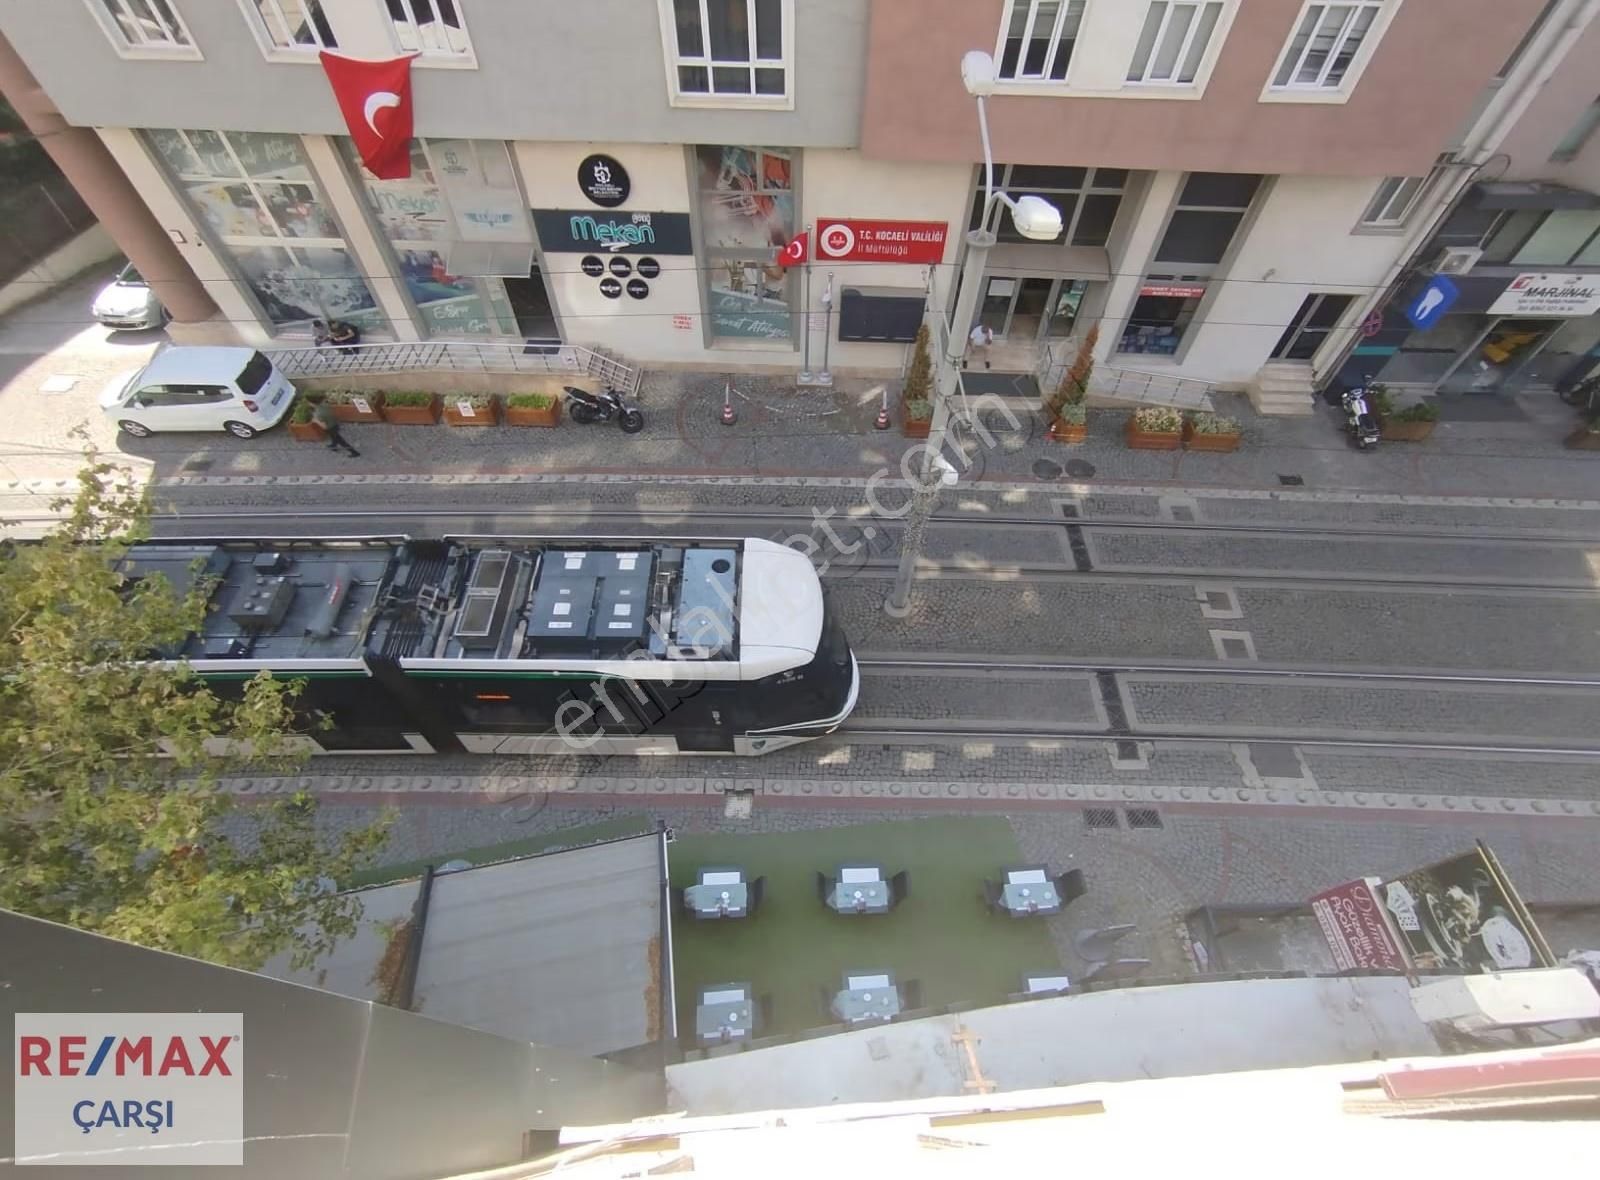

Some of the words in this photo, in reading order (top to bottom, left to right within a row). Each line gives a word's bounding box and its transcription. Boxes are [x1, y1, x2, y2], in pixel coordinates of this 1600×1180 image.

[859, 230, 873, 240] T.C.
[875, 230, 909, 242] KOCAELİ
[911, 231, 944, 242] VALİLİĞİ
[1523, 284, 1595, 298] MARJİNAL
